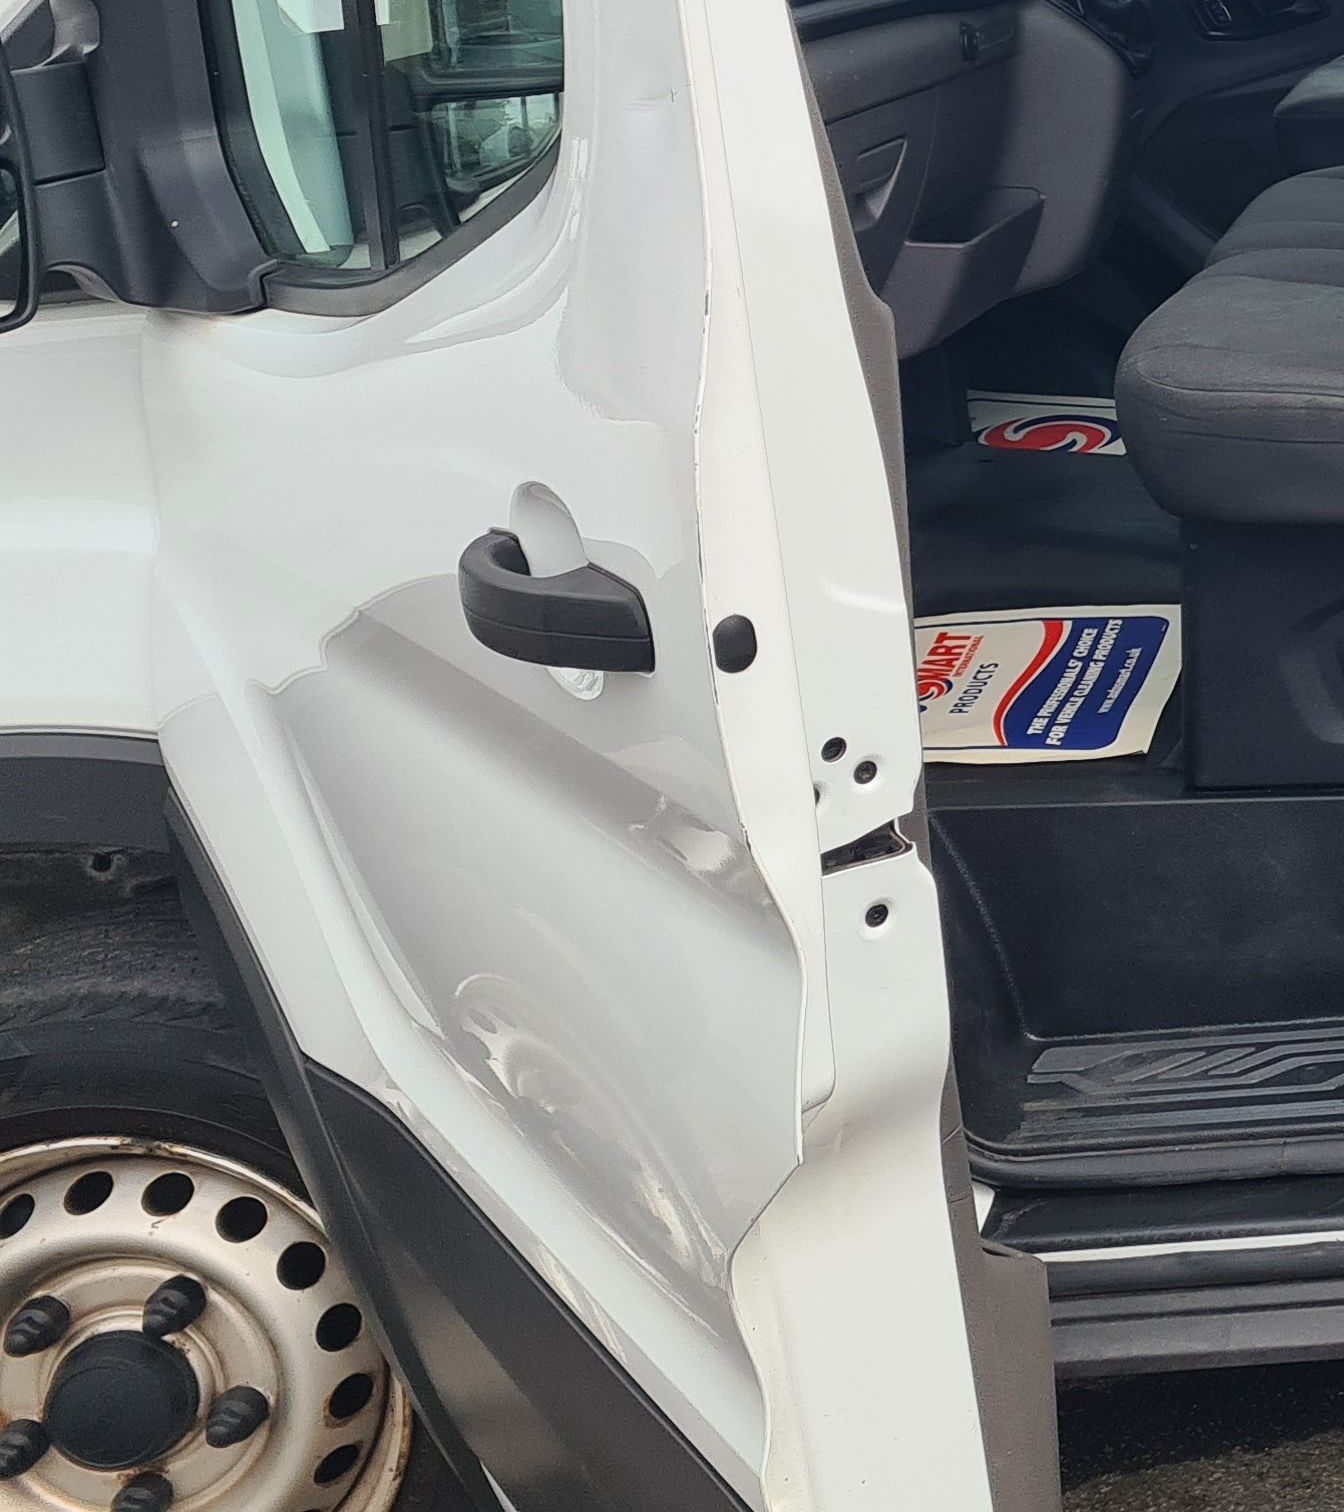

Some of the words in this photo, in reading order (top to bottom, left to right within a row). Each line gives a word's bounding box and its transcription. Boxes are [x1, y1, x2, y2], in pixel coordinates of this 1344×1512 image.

[1092, 619, 1123, 661] PRODUCTS
[948, 662, 1000, 715] PRODUCTS
[1026, 717, 1050, 735] THE
[1072, 628, 1099, 658] CHOICE
[1072, 661, 1105, 697] CLEANING
[1055, 696, 1086, 724] VEHICLE
[1045, 724, 1069, 746] FOR
